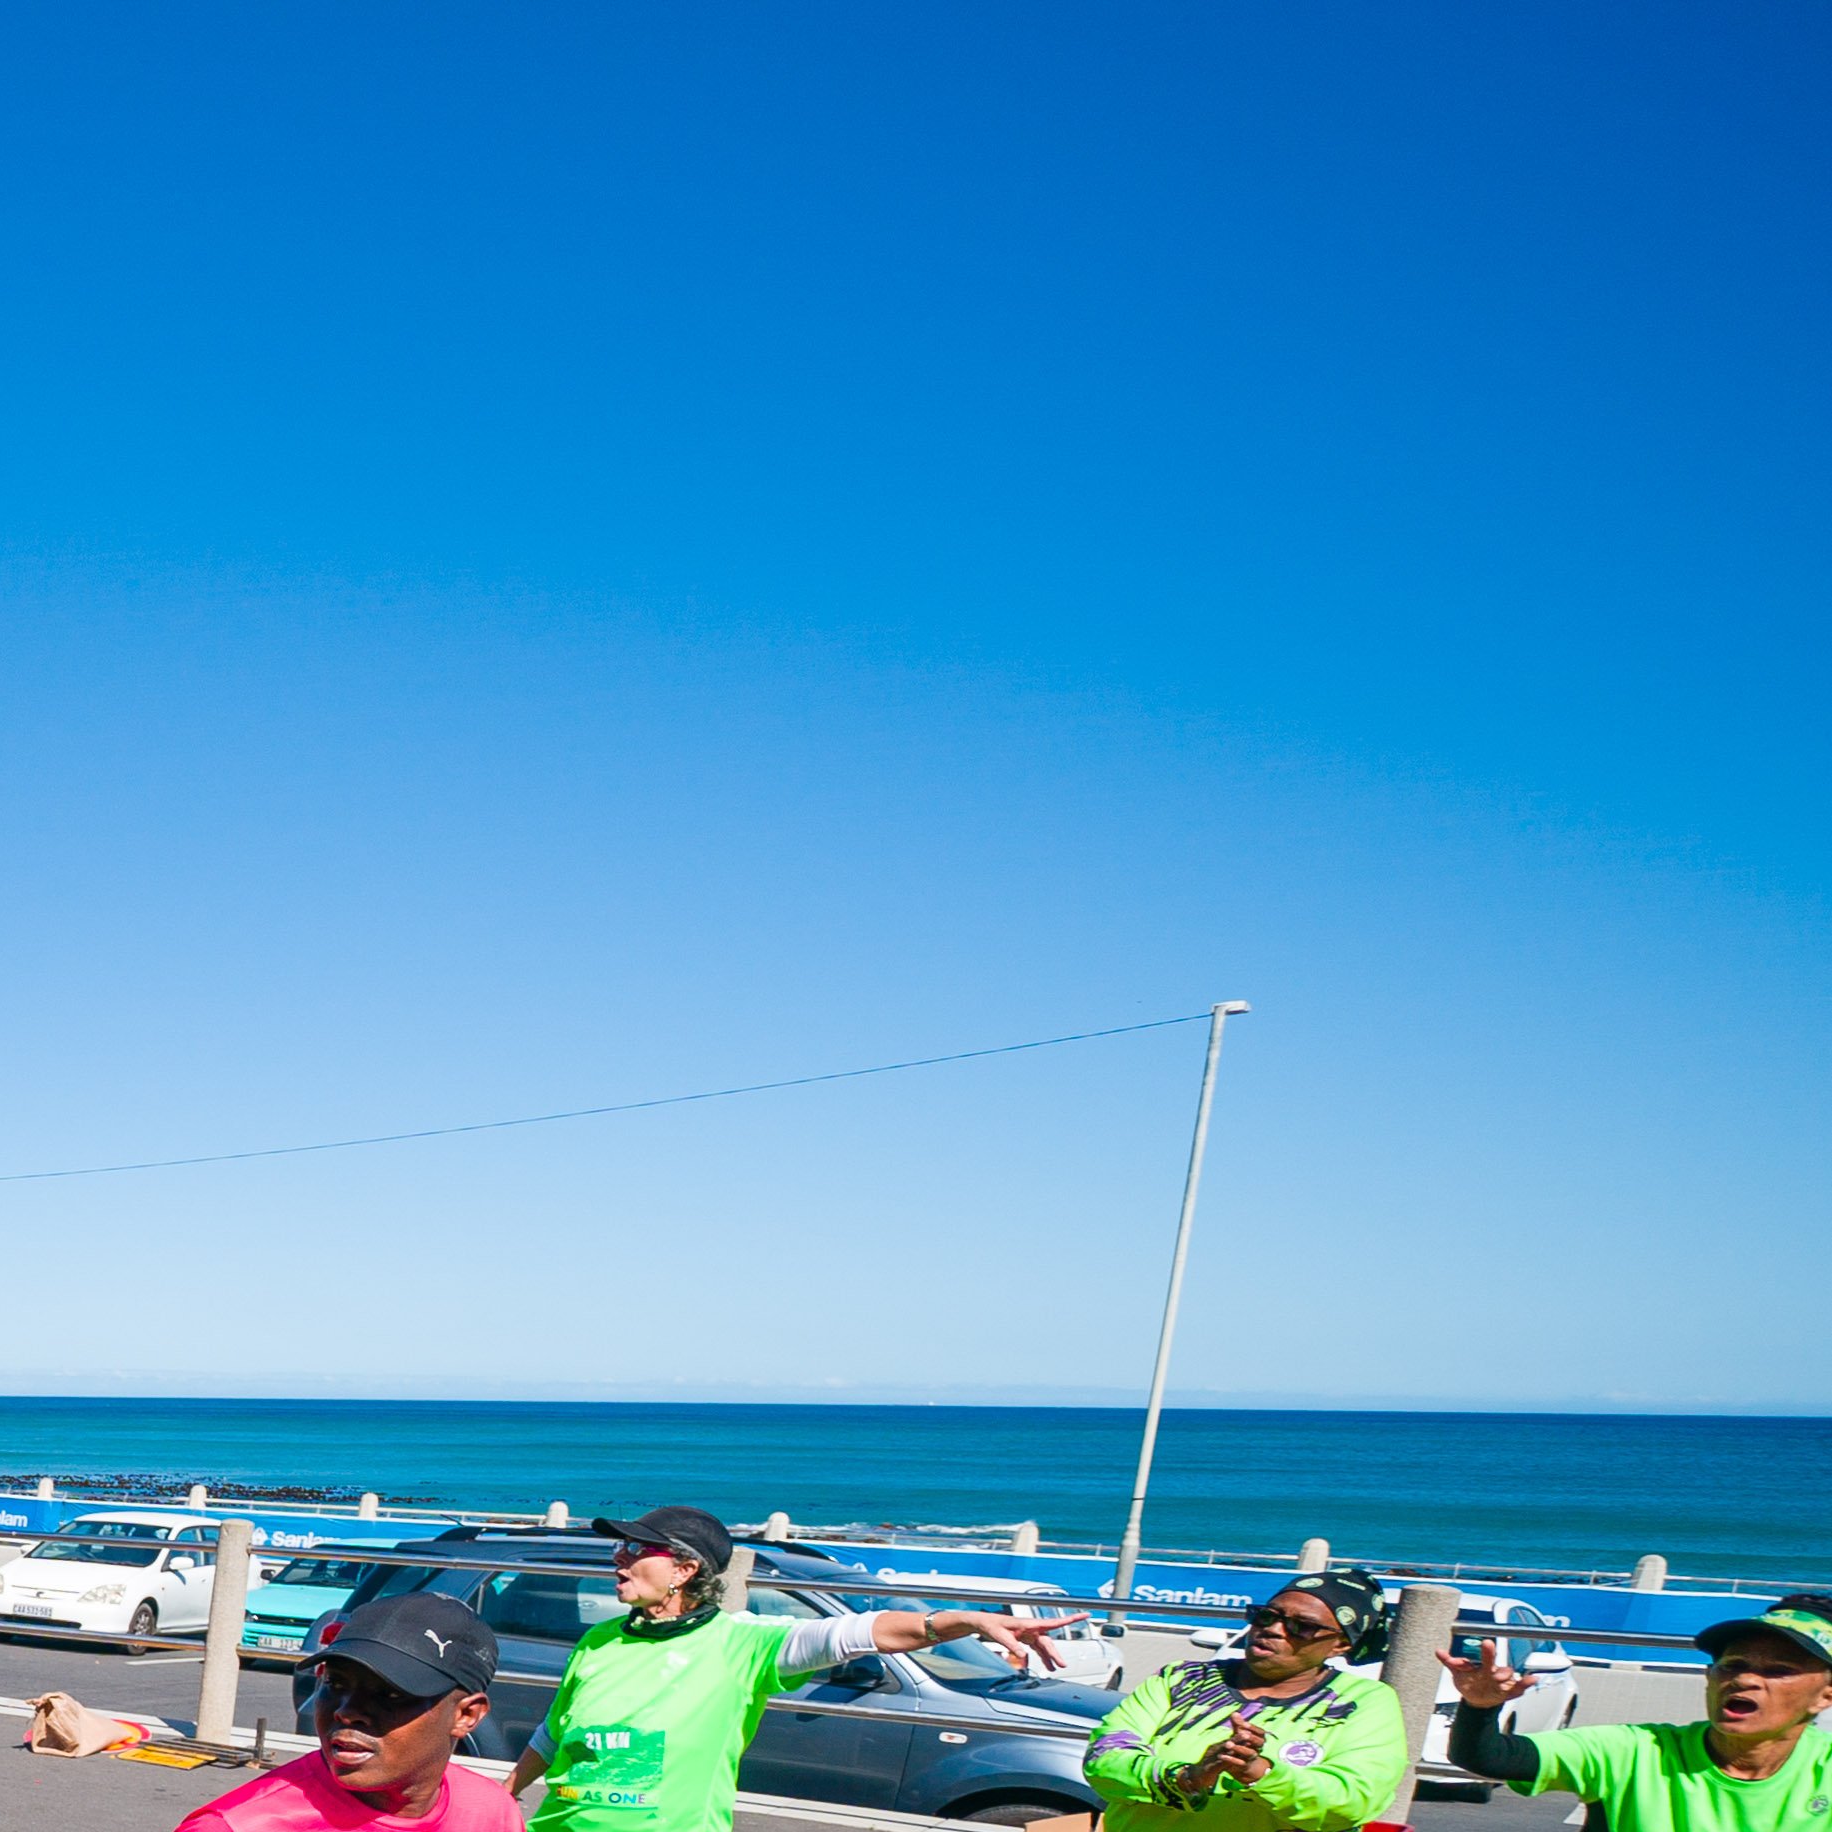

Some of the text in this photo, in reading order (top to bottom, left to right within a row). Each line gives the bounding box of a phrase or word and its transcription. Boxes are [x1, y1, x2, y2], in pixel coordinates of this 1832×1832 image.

[585, 1732, 602, 1751] 21
[583, 1790, 603, 1803] AS
[608, 1791, 647, 1805] ONE
